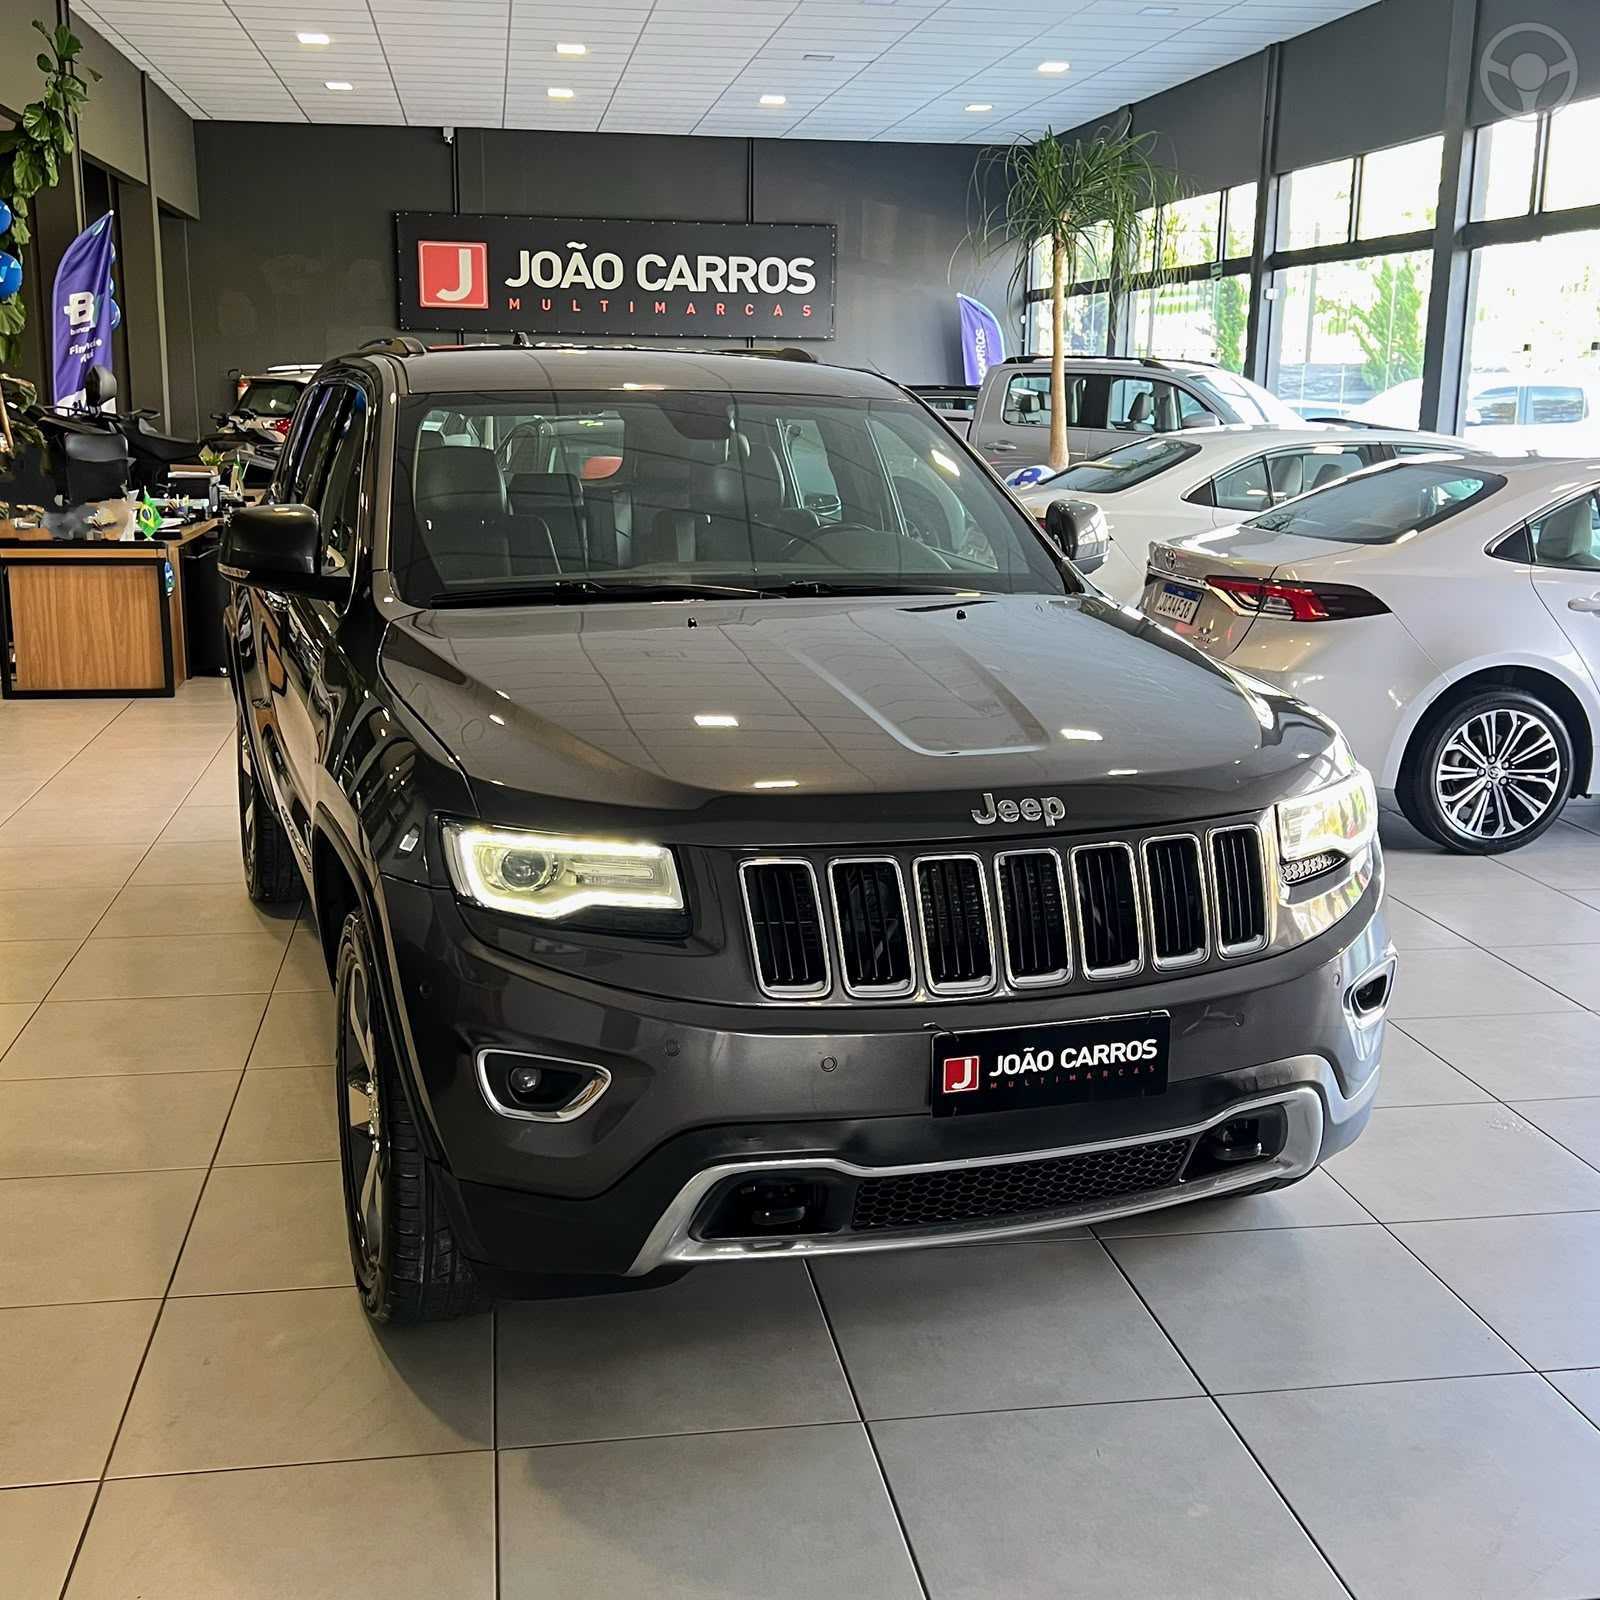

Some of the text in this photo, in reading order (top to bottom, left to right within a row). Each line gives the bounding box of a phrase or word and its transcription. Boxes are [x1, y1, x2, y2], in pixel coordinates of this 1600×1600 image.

[436, 248, 472, 301] J
[504, 241, 816, 294] JOÃO CARROS
[508, 298, 812, 317] MULTIMARCAS
[971, 793, 1066, 827] Jeep
[952, 1060, 971, 1088] J
[989, 1038, 1158, 1077] JOÃO CARROS
[990, 1065, 1156, 1089] MULTIMARCAS
